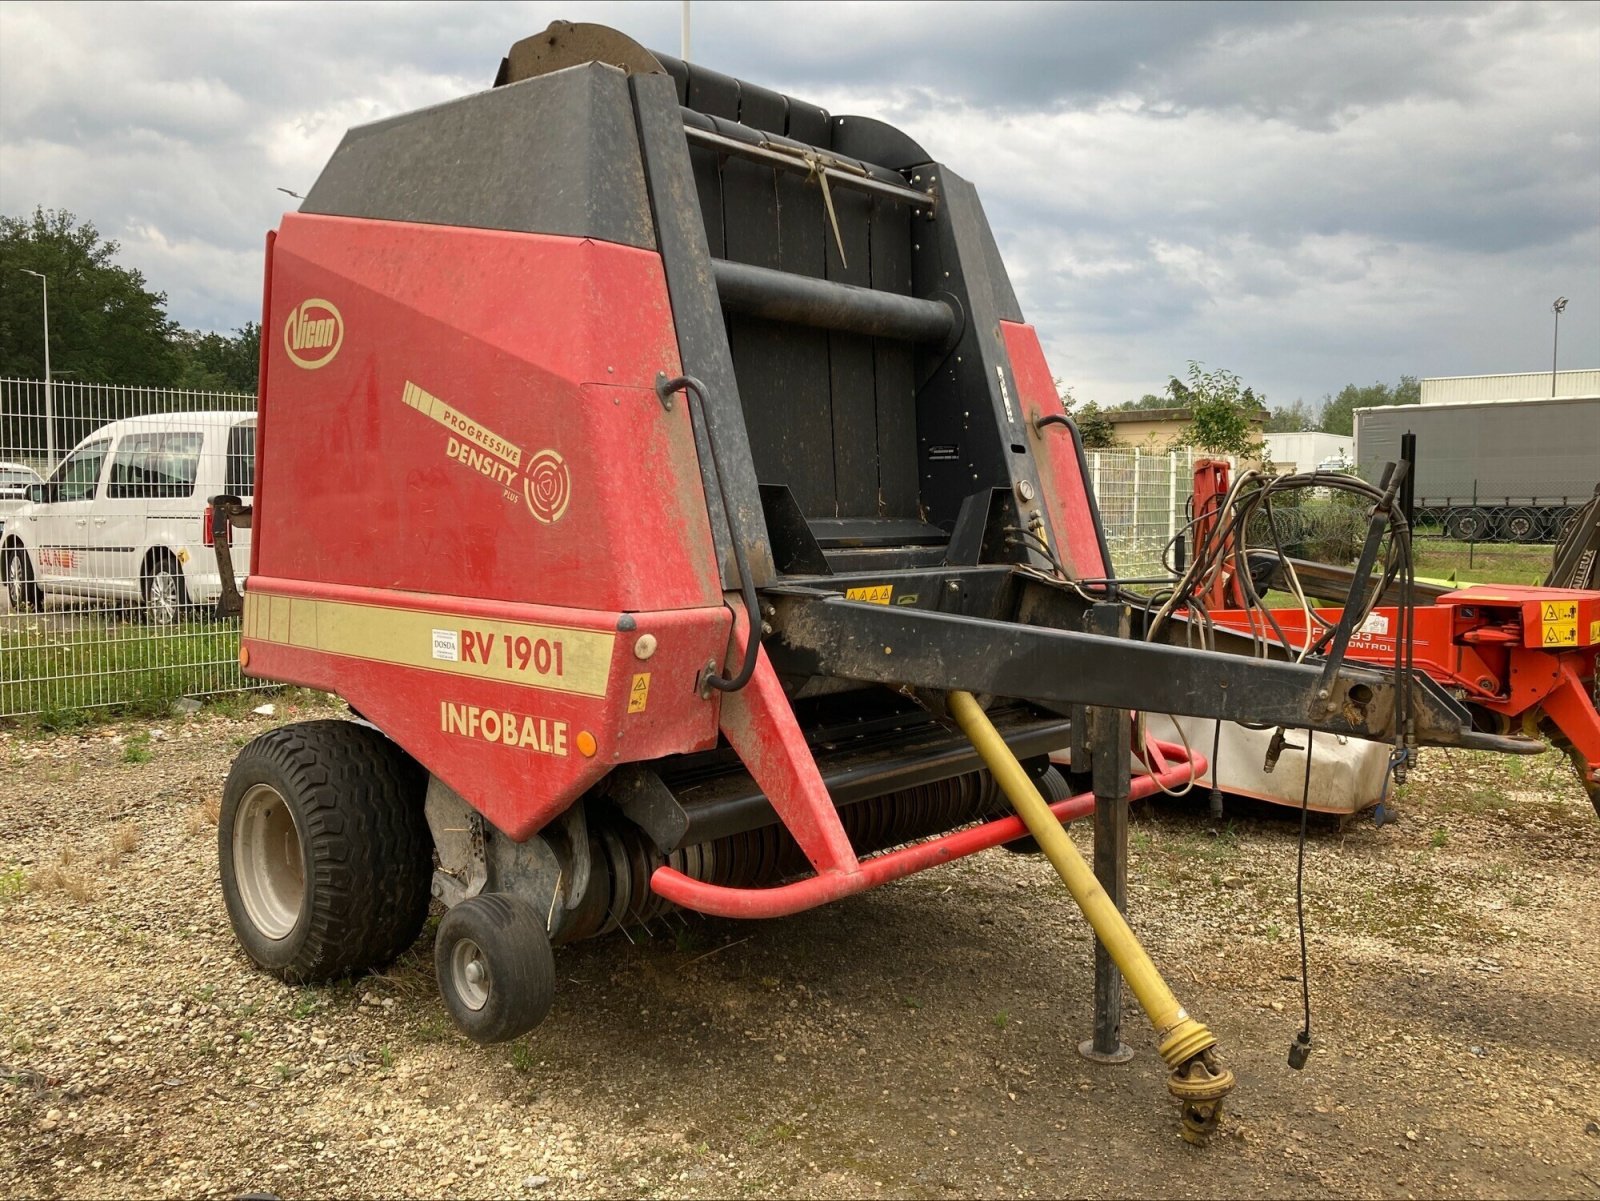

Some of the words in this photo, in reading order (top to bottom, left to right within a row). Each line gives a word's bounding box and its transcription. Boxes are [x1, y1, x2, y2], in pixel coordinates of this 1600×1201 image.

[290, 304, 337, 352] Vicon
[443, 411, 518, 461] PROGRESSIVE
[446, 437, 519, 486] DENSITY
[503, 489, 519, 503] PLUS
[1572, 548, 1595, 589] AILLEUX
[461, 630, 495, 665] RV
[503, 635, 563, 676] 1901
[1348, 641, 1395, 652] ONTROL
[441, 701, 567, 756] INFOBALE
